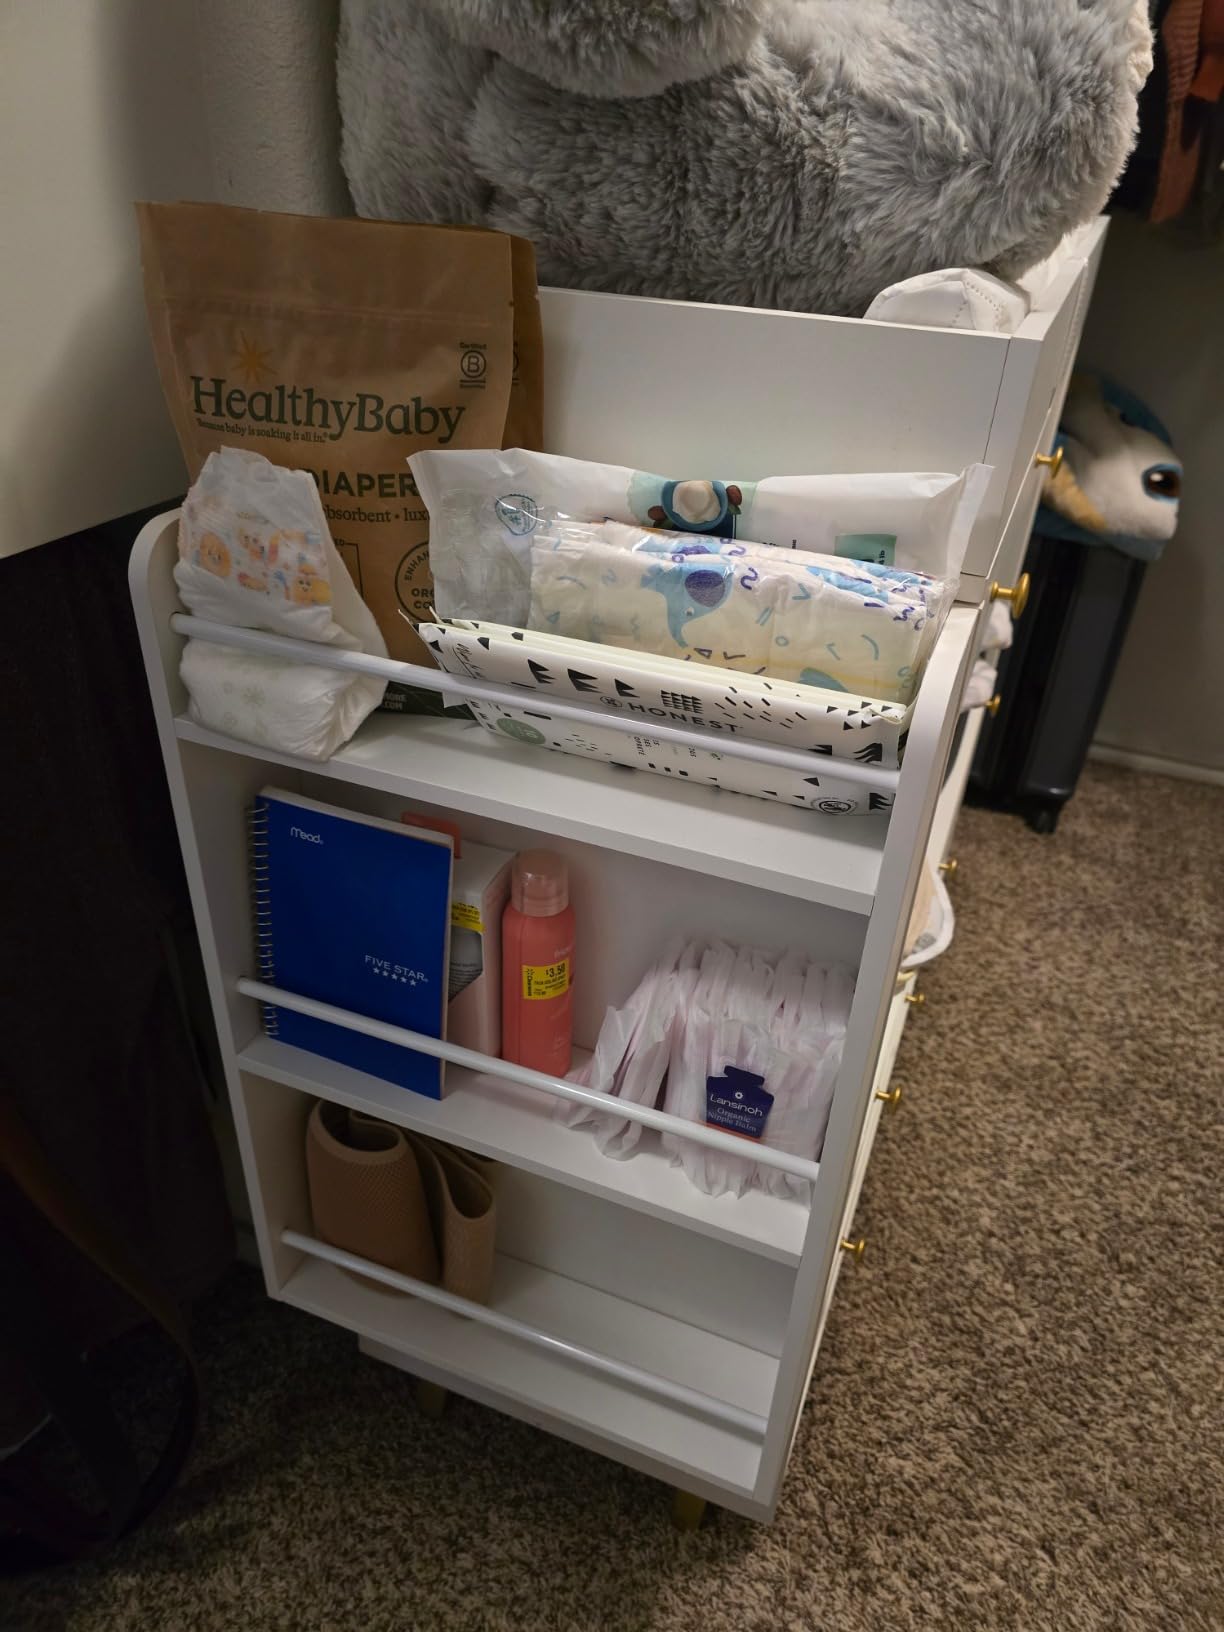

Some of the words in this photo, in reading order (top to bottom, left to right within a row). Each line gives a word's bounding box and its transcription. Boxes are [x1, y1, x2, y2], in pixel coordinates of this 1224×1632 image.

[190, 376, 466, 444] HealthyBaby
[225, 422, 247, 437] baby
[247, 425, 256, 436] is
[256, 427, 292, 442] soaking
[300, 430, 312, 441] all
[322, 505, 392, 523] bsorbent
[414, 600, 433, 610] CO
[626, 702, 739, 733] HONEST
[365, 954, 391, 971] FIVE
[709, 1093, 764, 1117] Lansinoh
[708, 1111, 734, 1125] Nipple
[717, 1107, 752, 1123] Organic
